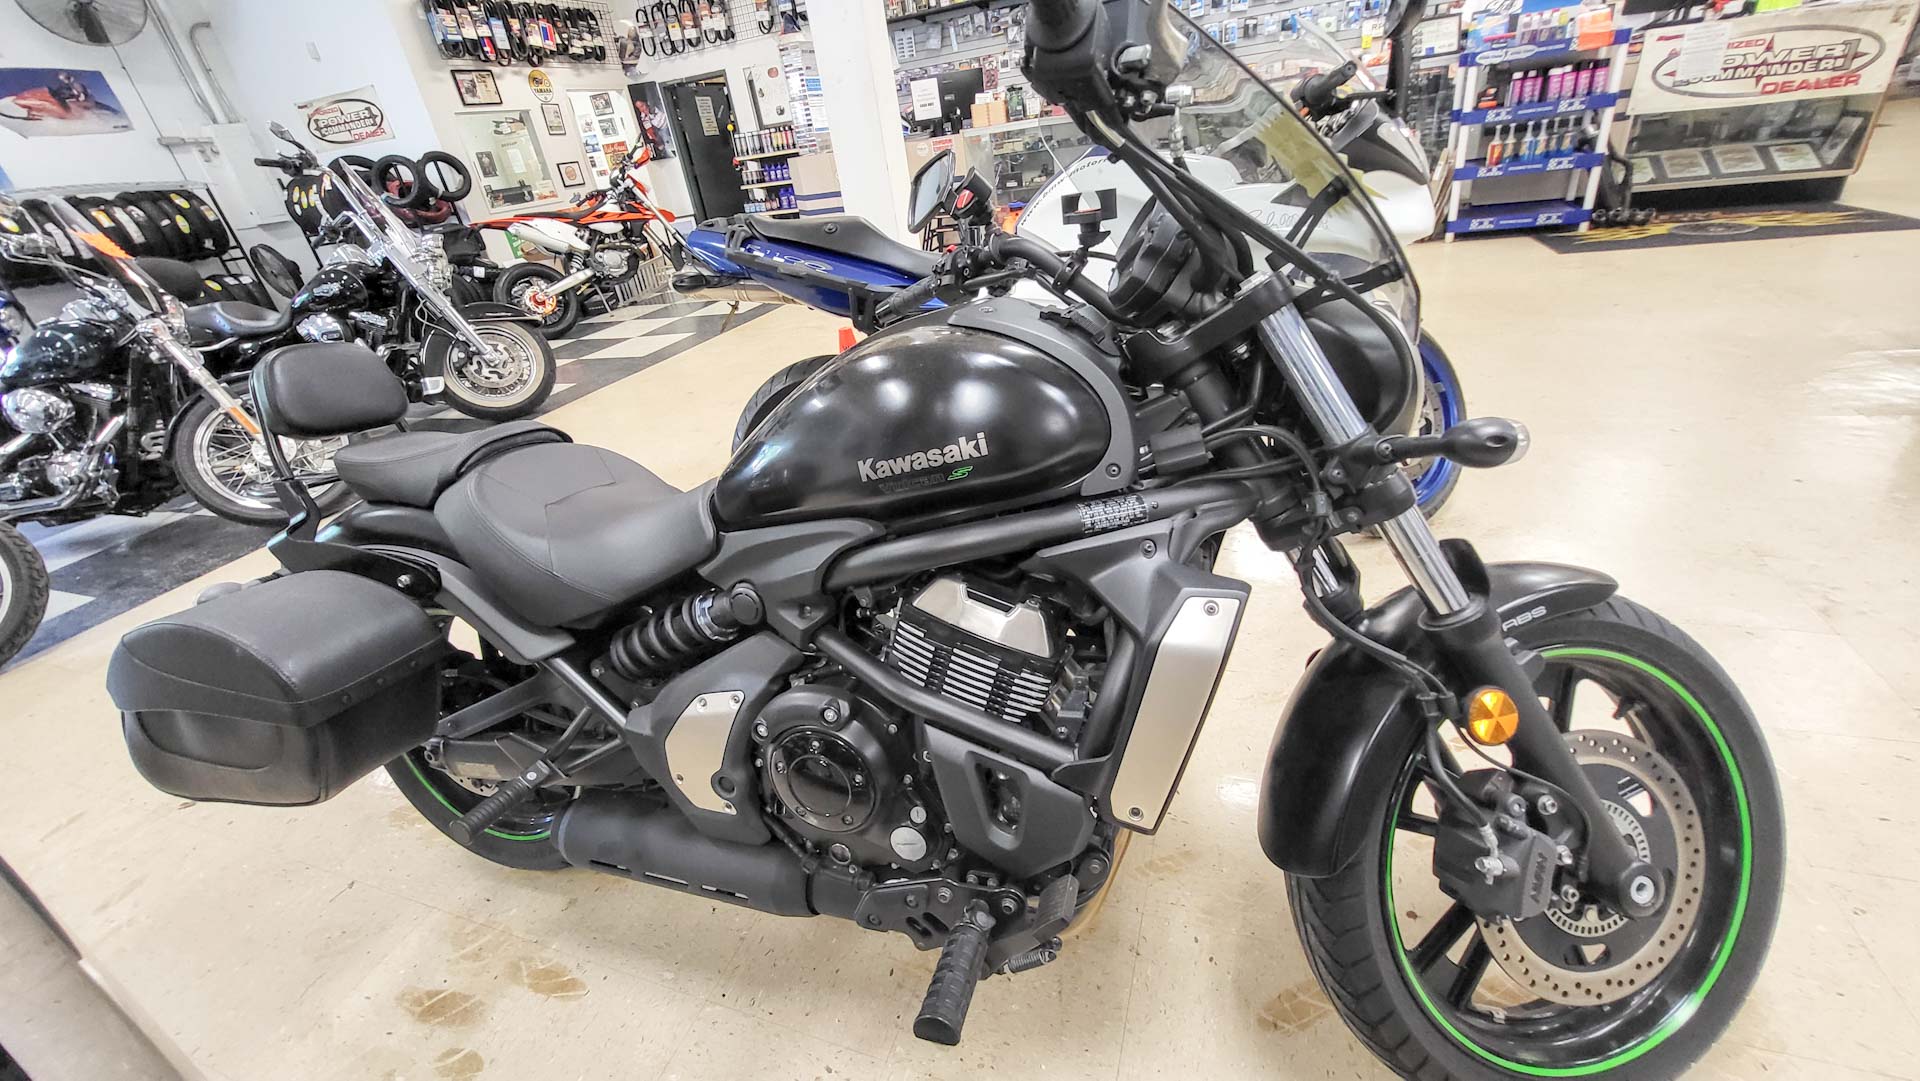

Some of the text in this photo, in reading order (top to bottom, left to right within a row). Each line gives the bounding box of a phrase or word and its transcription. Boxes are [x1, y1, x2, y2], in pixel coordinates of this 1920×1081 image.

[1722, 43, 1847, 68] OWER
[1760, 74, 1862, 95] DEALER
[317, 109, 371, 127] POWER
[353, 128, 386, 141] DEALER
[857, 431, 989, 482] Kawasaki
[946, 465, 974, 480] S
[1501, 605, 1547, 632] ABS
